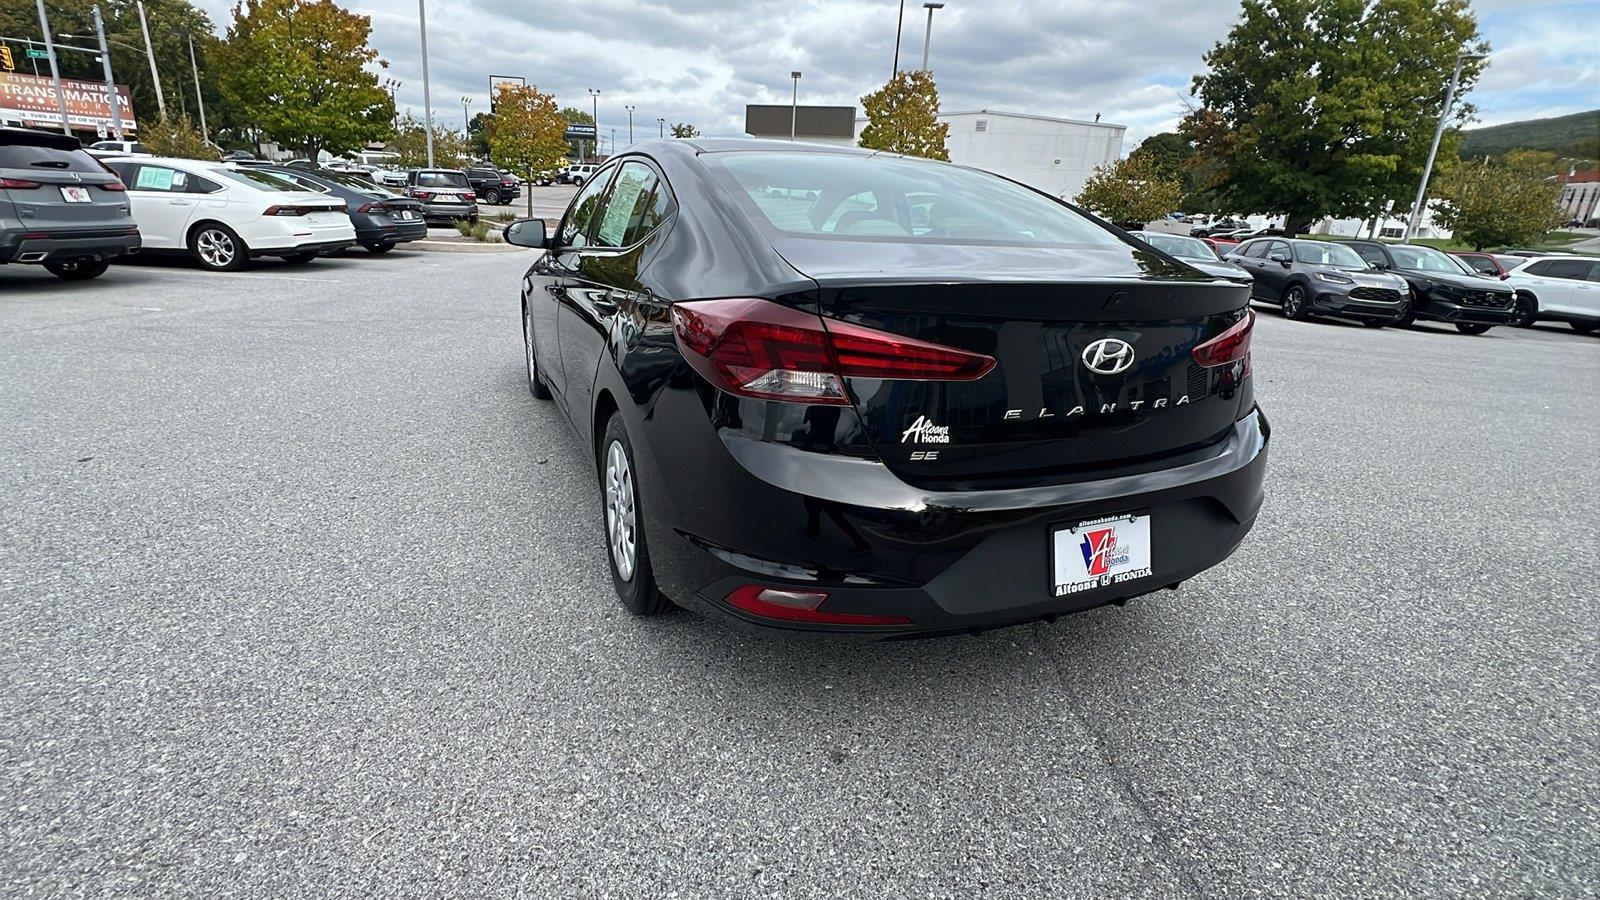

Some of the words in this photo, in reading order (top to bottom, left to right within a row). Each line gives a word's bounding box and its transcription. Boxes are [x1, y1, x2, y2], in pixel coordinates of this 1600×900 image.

[20, 76, 36, 84] WHO
[67, 81, 80, 89] IT'S
[80, 83, 98, 91] WHAT
[1003, 395, 1190, 419] ELANTRA
[901, 415, 949, 443] Altoona
[921, 433, 950, 444] Honda
[909, 450, 940, 461] SE
[1078, 513, 1132, 527] altoonahonda.com
[1055, 580, 1098, 596] Altoona
[1113, 567, 1153, 583] HONDA
